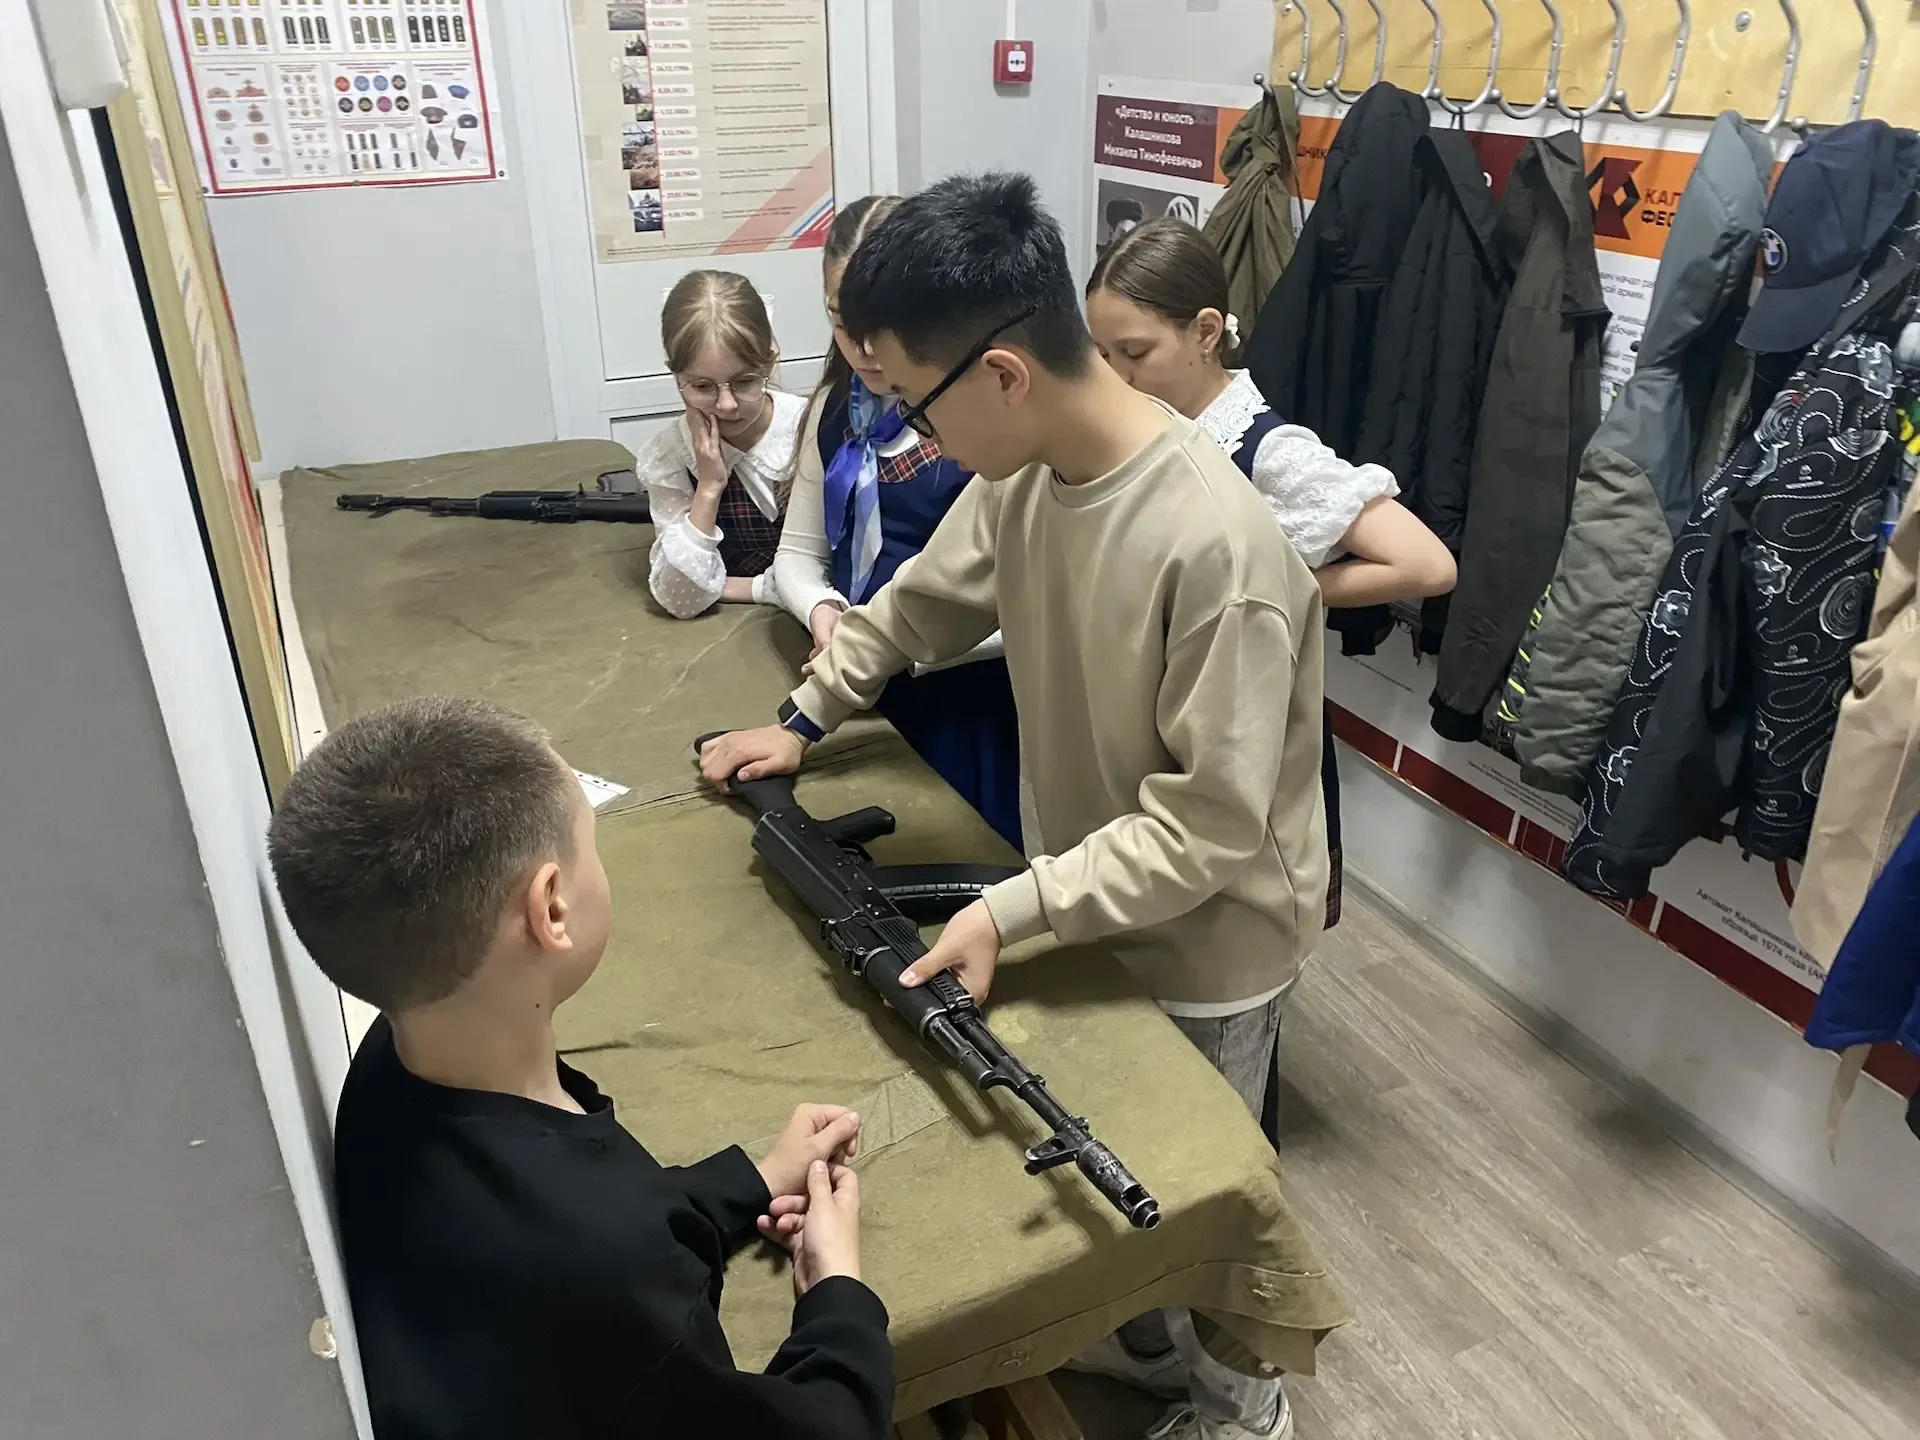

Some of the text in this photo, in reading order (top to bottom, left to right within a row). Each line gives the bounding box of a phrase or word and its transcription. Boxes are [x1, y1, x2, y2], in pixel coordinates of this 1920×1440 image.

[1114, 104, 1195, 126] «Детство и юность
[1124, 125, 1182, 145] Калашникова
[1104, 143, 1204, 169] Михаила Тимофеевича»
[1696, 888, 1733, 914] Автомат
[1762, 938, 1784, 957] 1974
[1784, 953, 1807, 971] года
